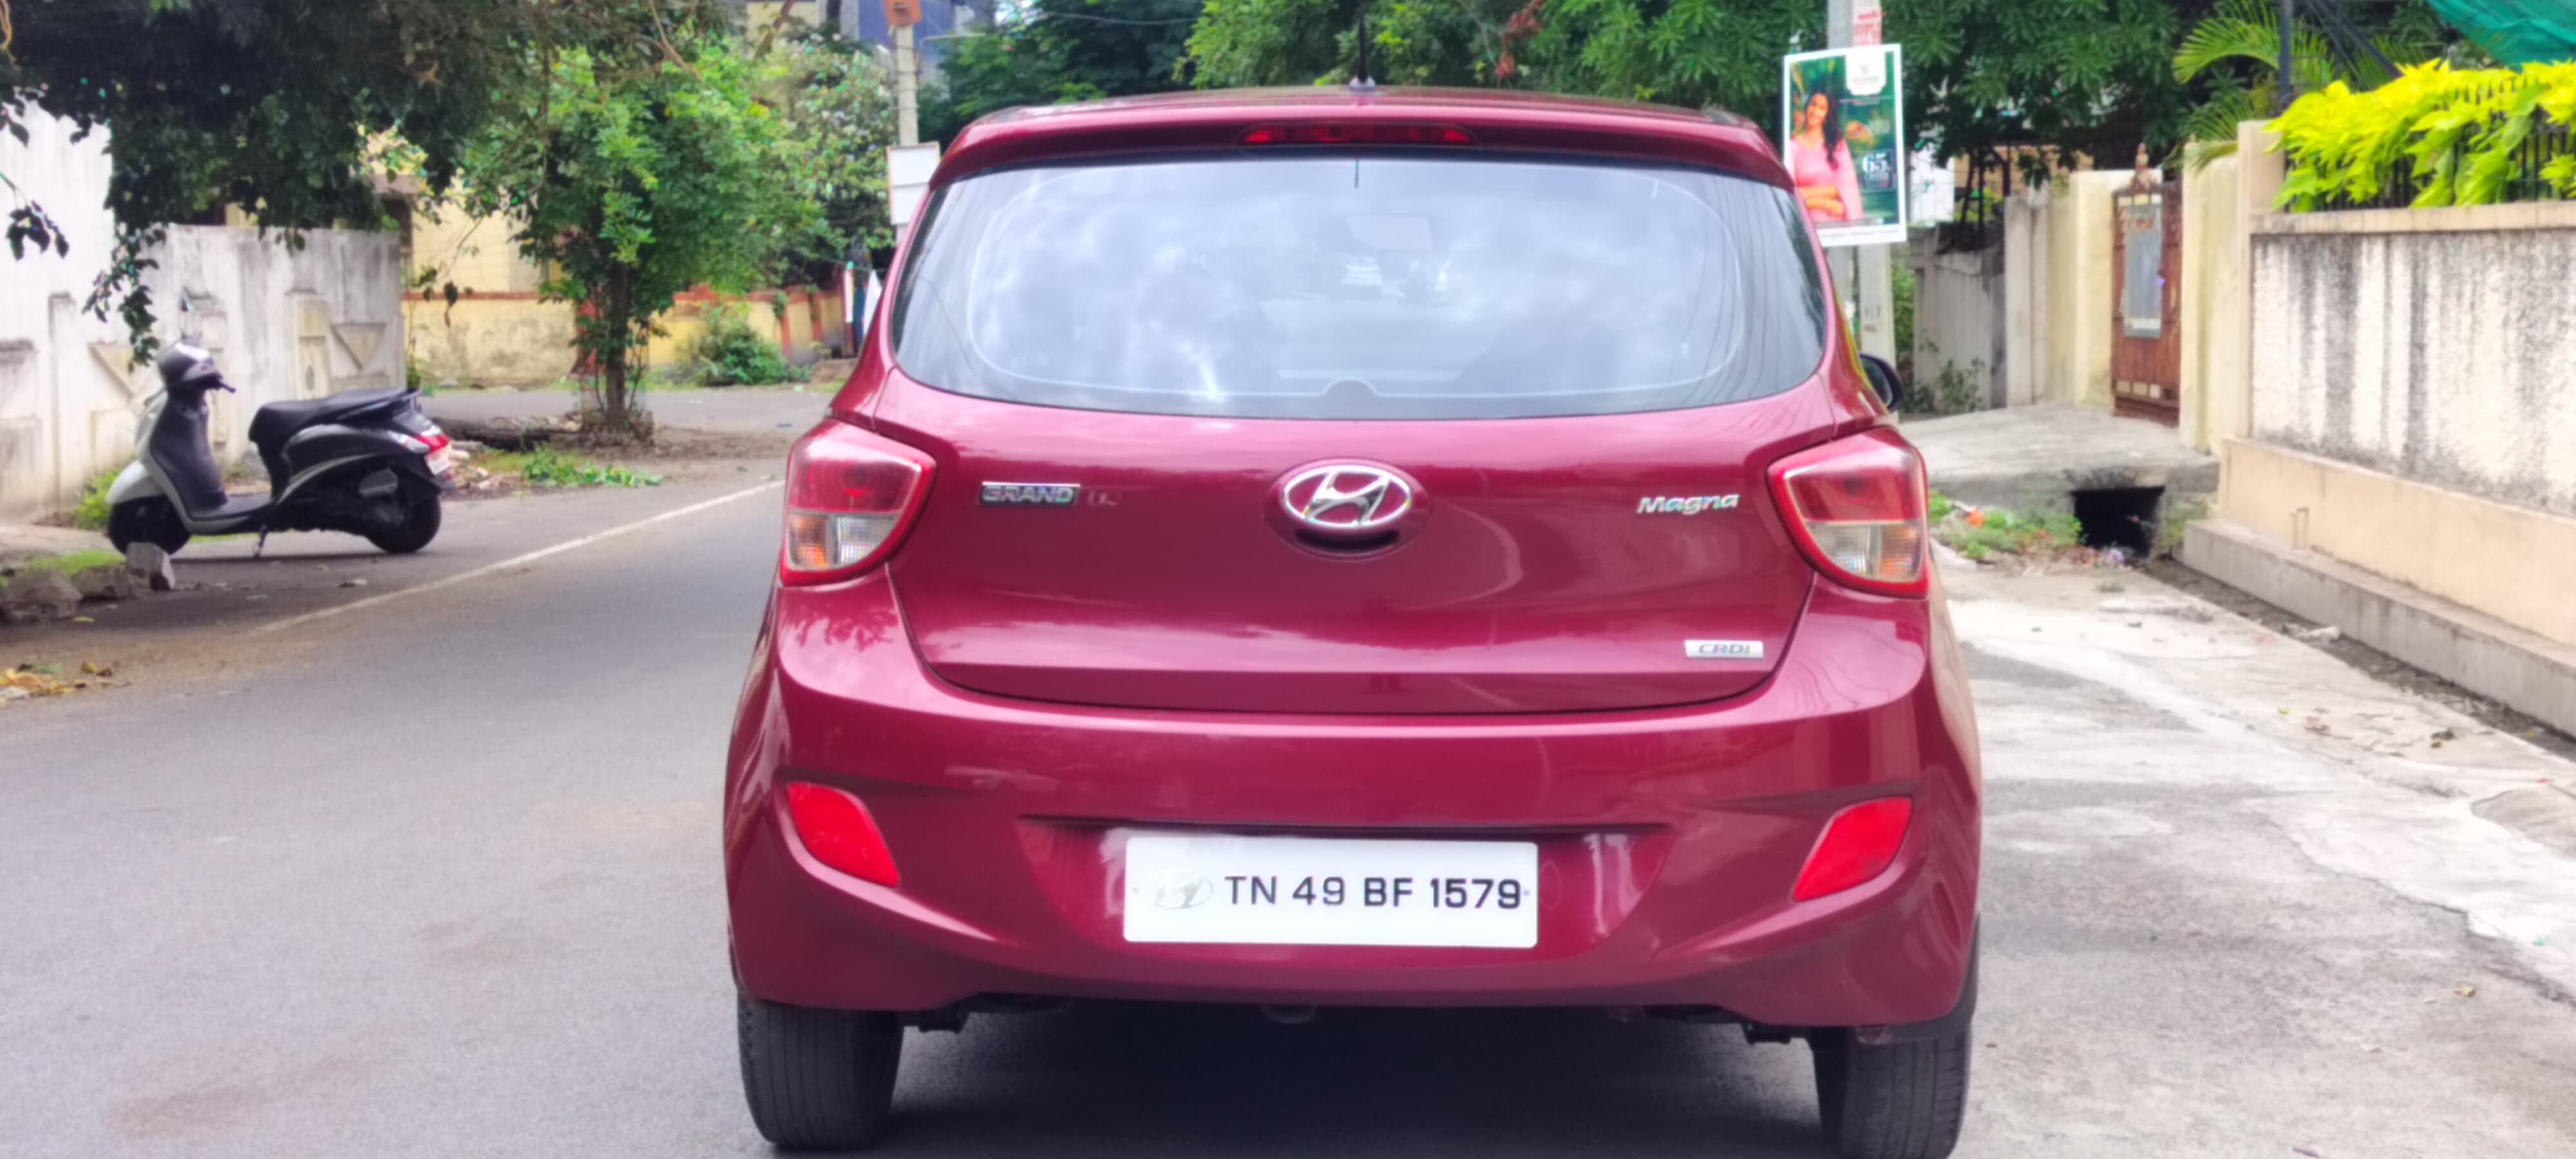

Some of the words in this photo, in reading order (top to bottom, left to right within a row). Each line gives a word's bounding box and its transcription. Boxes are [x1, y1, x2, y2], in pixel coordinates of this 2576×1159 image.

[981, 484, 1075, 504] GRAND
[1636, 493, 1740, 515] Magna
[1224, 875, 1277, 905] TN
[1292, 875, 1345, 906] 49
[1363, 877, 1413, 907] BF
[1430, 878, 1521, 909] 1579
